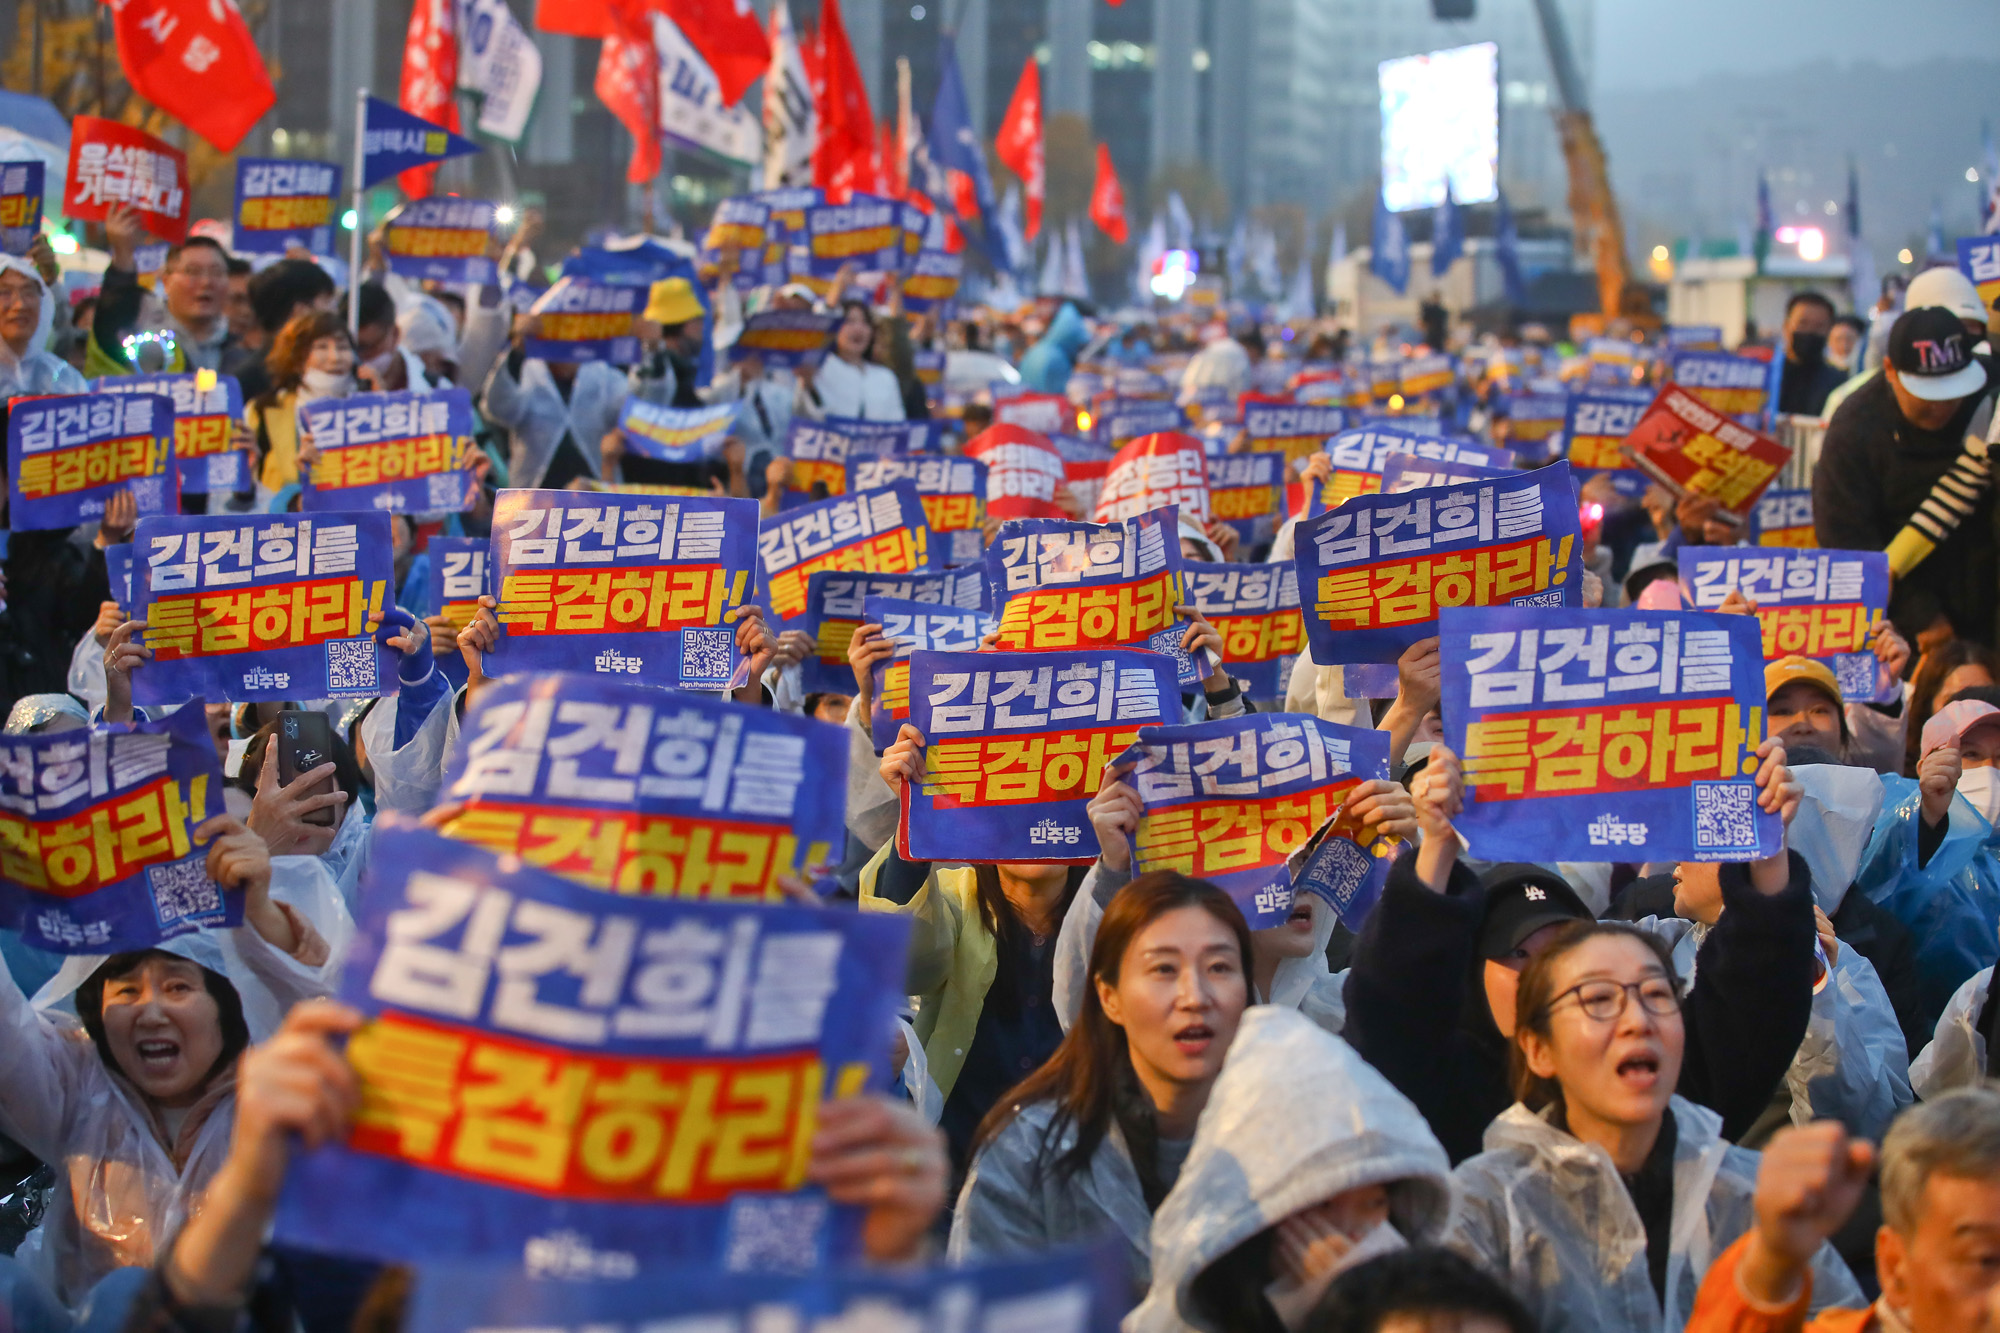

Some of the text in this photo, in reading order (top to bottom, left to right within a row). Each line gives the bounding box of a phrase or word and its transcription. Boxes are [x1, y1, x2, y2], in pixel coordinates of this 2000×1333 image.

[1912, 334, 1963, 368] TMT
[20, 398, 154, 453] 김건희를
[311, 400, 449, 449] 김건희를
[17, 437, 170, 495] 특검하라!
[310, 435, 466, 488] 특검하라!
[509, 504, 725, 564] 김건희를
[759, 491, 903, 574] 김건희를
[1313, 484, 1544, 566] 김건희를
[147, 520, 359, 592] 김건희를
[1001, 521, 1167, 592] 김건희를
[1315, 534, 1575, 626] 특검하라!
[1694, 555, 1864, 606] 김건희를
[142, 579, 387, 654] 특검하라!
[496, 570, 748, 631] 특검하라!
[998, 570, 1184, 649] 특검하라!
[1184, 566, 1301, 614] 건희를
[1754, 606, 1883, 656] 하라!
[243, 672, 290, 690] 민주당
[594, 655, 643, 674] 민주당
[1466, 620, 1733, 708] 김건희를
[928, 660, 1160, 733] 김건희를
[451, 697, 806, 818] 김건희를
[1133, 720, 1352, 801] 김건희를
[1462, 704, 1763, 795] 특검하라!
[1029, 826, 1081, 844] 민주당
[1037, 818, 1057, 828] 더불어
[1588, 823, 1648, 846] 민주당
[1255, 891, 1297, 914] 민주
[1522, 884, 1547, 901] LA
[370, 871, 844, 1050] 김건희를
